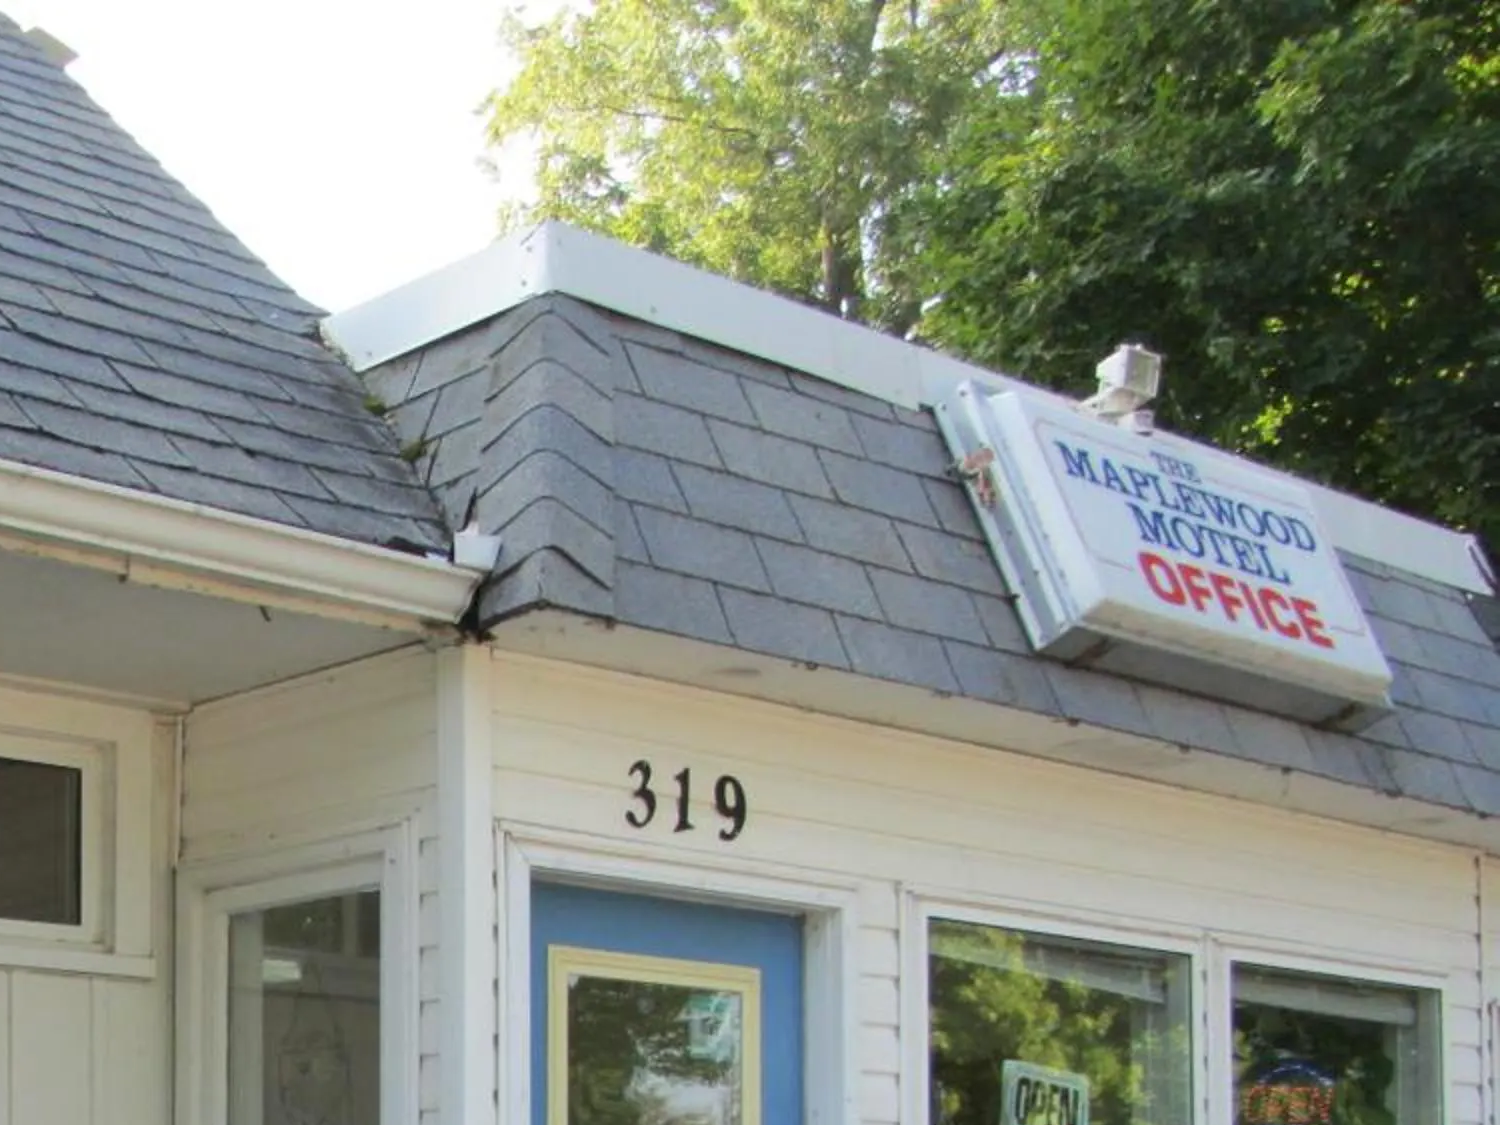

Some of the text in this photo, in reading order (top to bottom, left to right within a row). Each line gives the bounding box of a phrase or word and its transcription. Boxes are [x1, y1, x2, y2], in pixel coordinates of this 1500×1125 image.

[1054, 440, 1317, 554] MAPLEWOOD
[1150, 450, 1201, 484] THE
[1126, 502, 1291, 585] MOTEL
[1138, 552, 1336, 650] OFFICE
[625, 759, 747, 842] 319
[1247, 1086, 1335, 1124] OPEN
